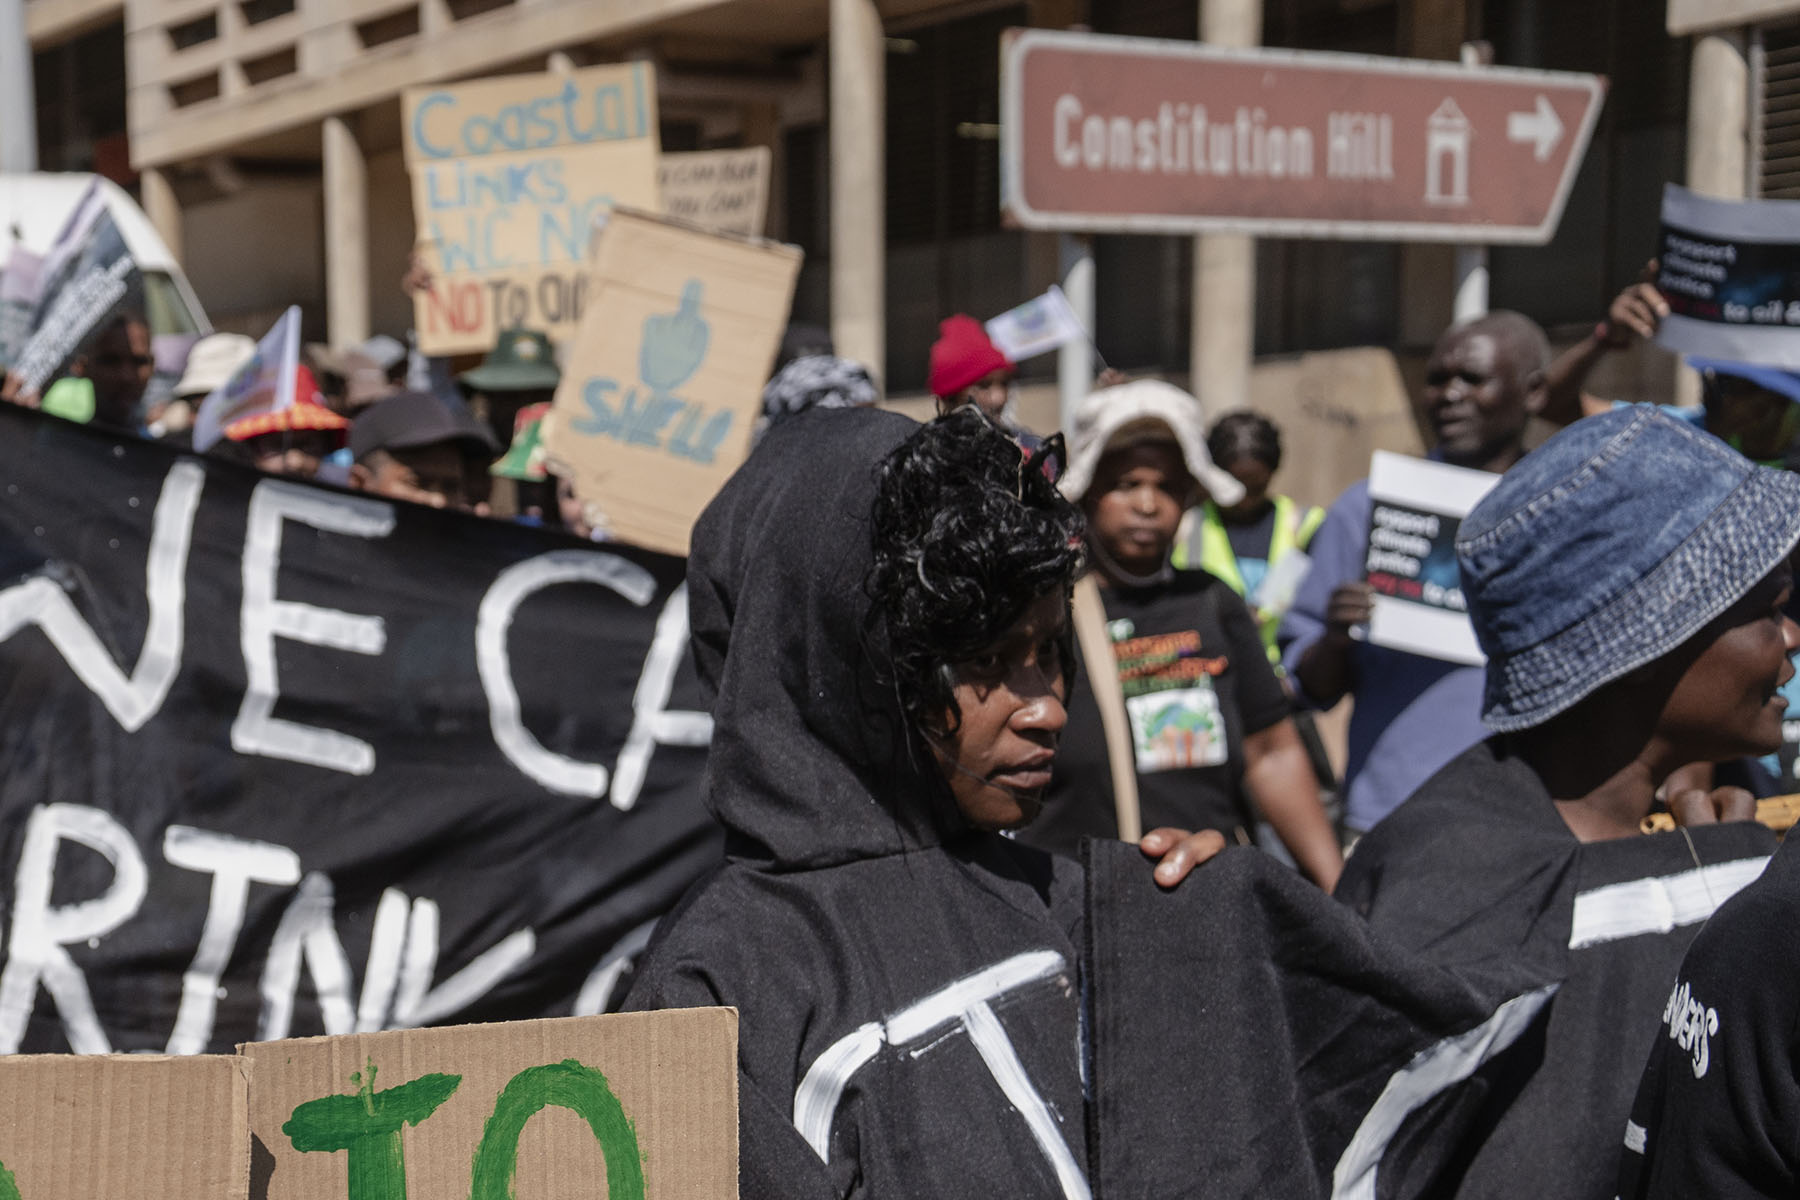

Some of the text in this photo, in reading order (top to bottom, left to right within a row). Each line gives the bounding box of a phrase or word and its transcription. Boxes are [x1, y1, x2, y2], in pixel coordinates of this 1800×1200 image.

[411, 62, 647, 159] Coastal
[1053, 93, 1394, 180] Constitution Hill
[426, 280, 484, 334] NO
